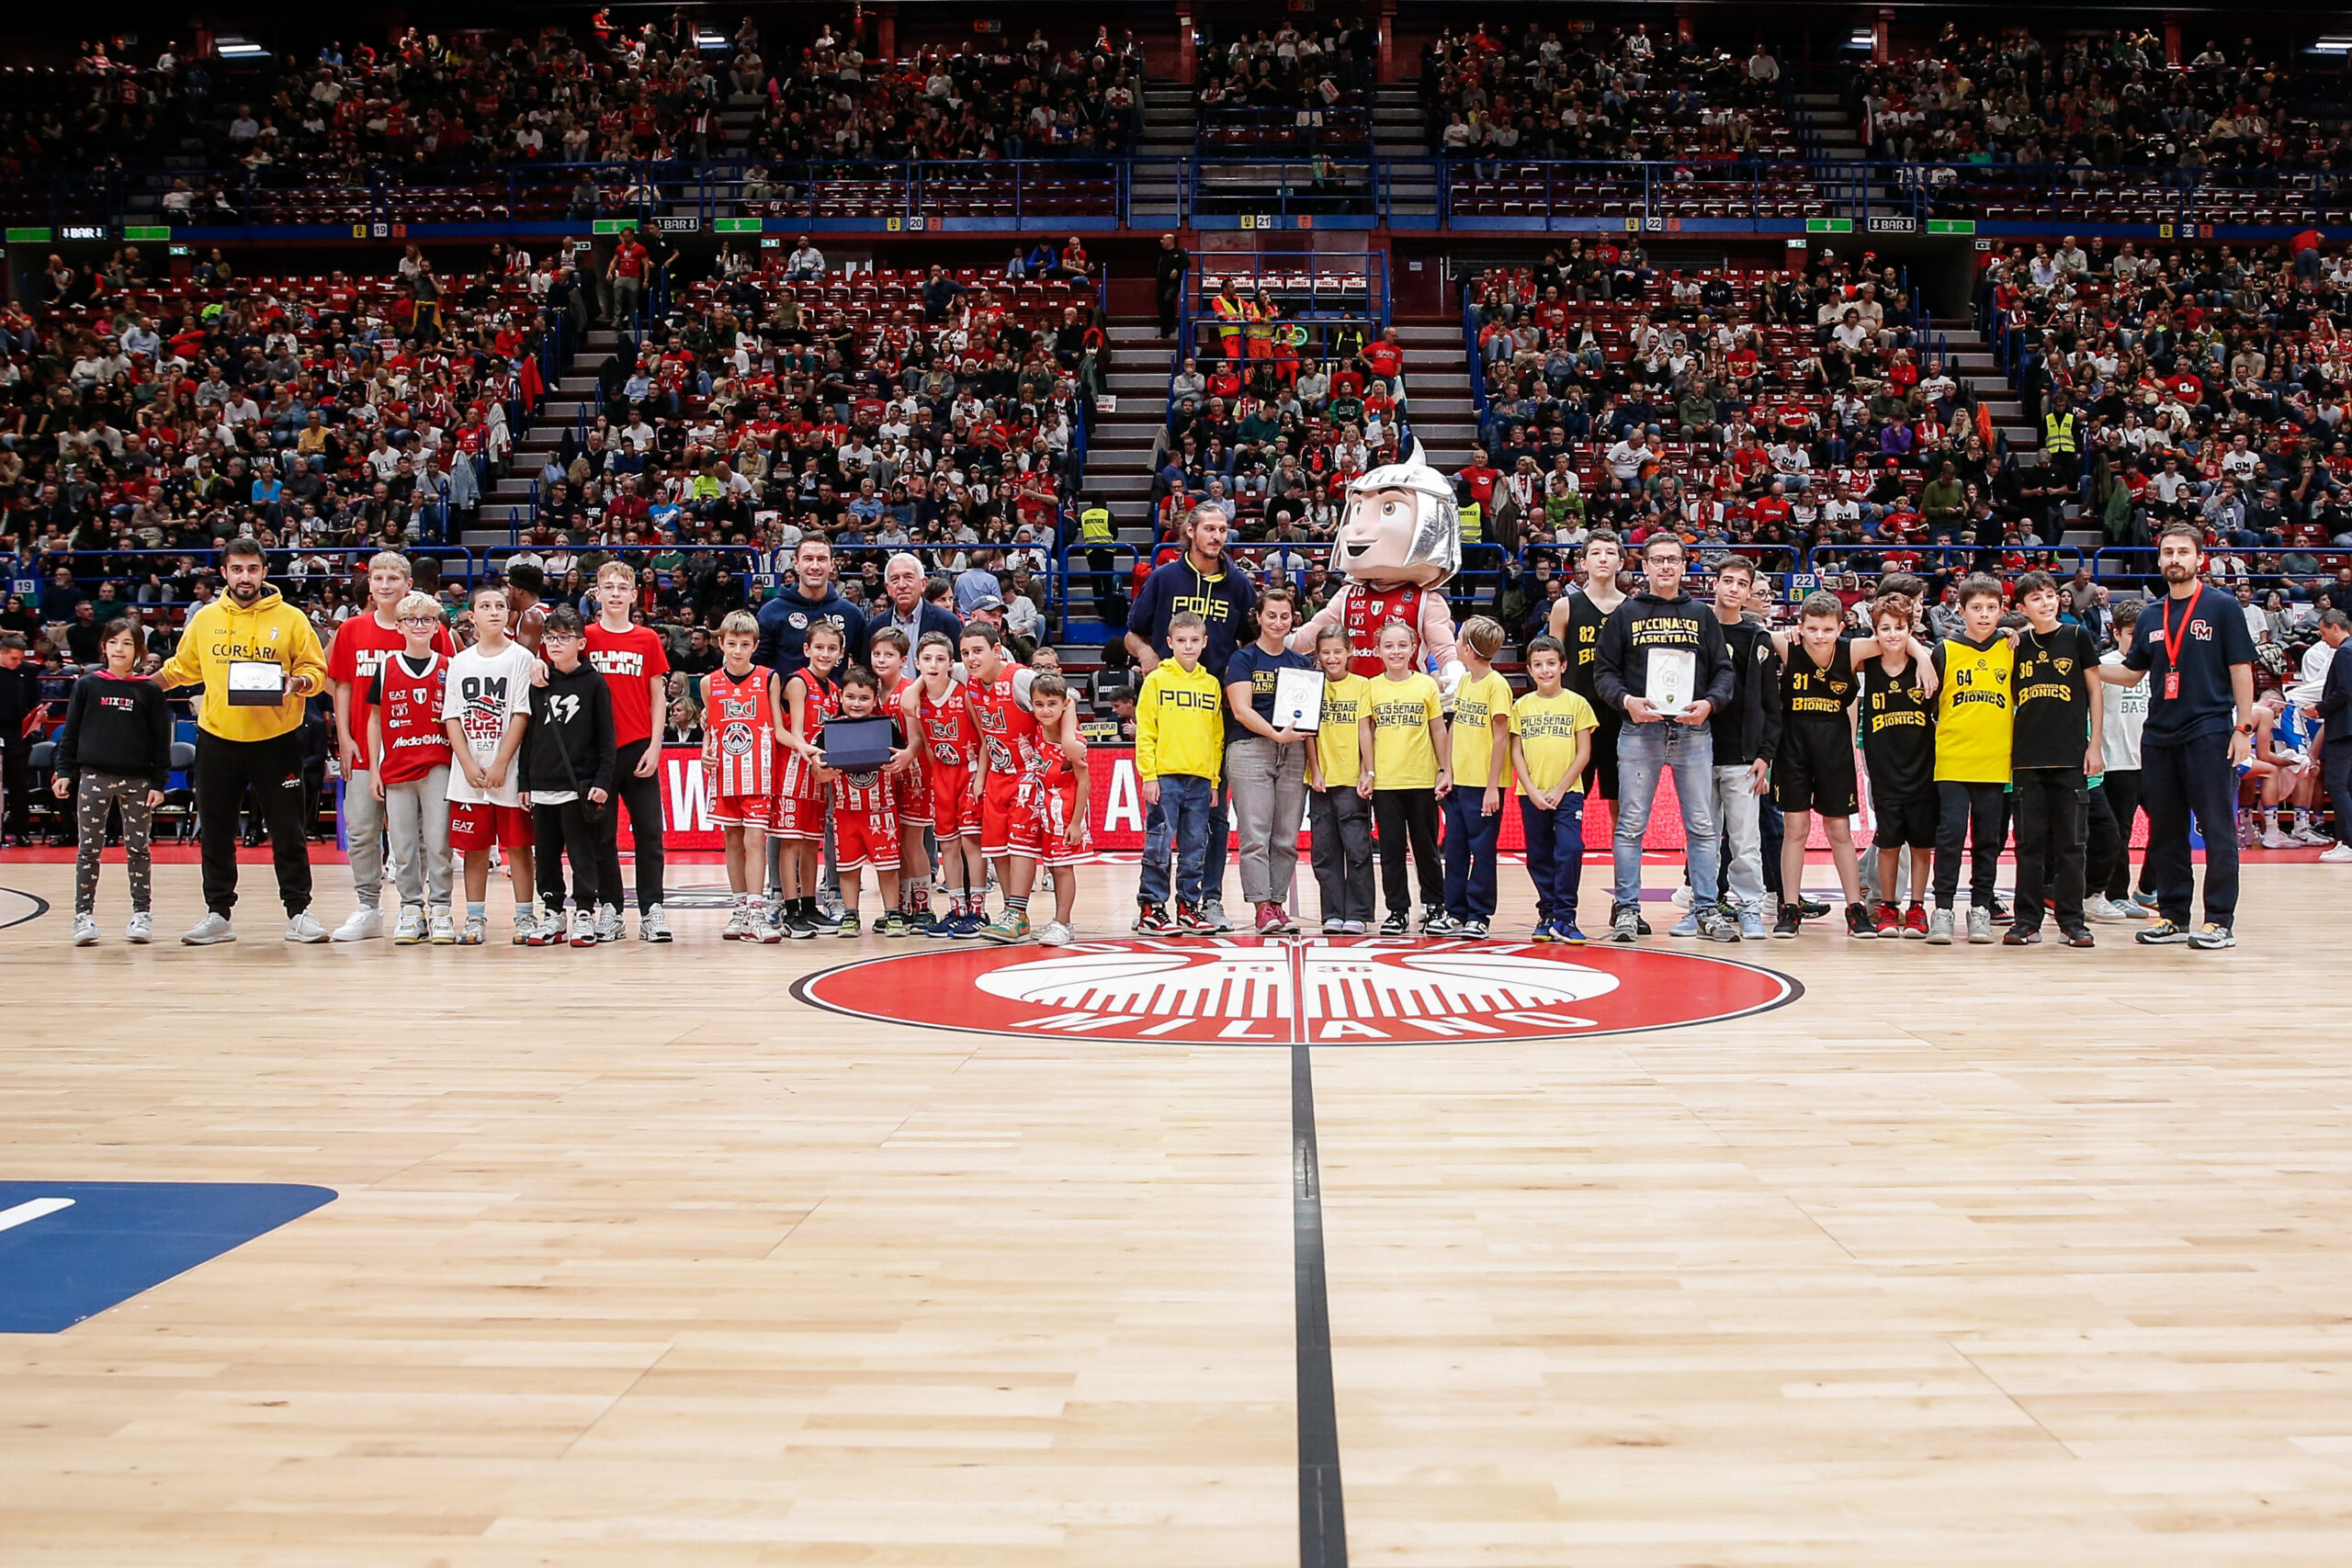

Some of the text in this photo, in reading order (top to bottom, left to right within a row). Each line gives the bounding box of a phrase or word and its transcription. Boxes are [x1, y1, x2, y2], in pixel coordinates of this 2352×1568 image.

[665, 220, 687, 230] BAR
[911, 220, 922, 228] 20
[1259, 218, 1270, 226] 21
[1649, 220, 1661, 228] 22
[1881, 220, 1904, 230] BAR
[70, 228, 95, 239] BAR
[375, 226, 386, 234] 19
[17, 581, 31, 591] 19
[1796, 576, 1812, 586] 22
[1579, 626, 1596, 643] 82
[589, 650, 644, 666] OLIMPIA
[2019, 660, 2034, 679] 36
[752, 676, 763, 690] 2
[1792, 672, 1809, 691] 31
[1956, 669, 1973, 686] 64
[389, 690, 407, 699] EA7
[462, 676, 507, 701] OM
[994, 681, 1011, 696] 53
[100, 696, 135, 707] MIXED!
[889, 694, 900, 705] 27
[948, 695, 964, 708] 62
[1792, 697, 1841, 713] BIONICS
[1952, 691, 2007, 709] BIONICS
[718, 695, 758, 718] Ted
[924, 716, 959, 739] Ted
[1080, 722, 1117, 732] INSTANT REPLAY
[1871, 710, 1927, 733] BIONICS
[476, 740, 495, 750] EA7
[451, 818, 475, 830] EA7
[1057, 937, 1540, 955] OLIMPIA
[1008, 1010, 1600, 1040] MILANO
